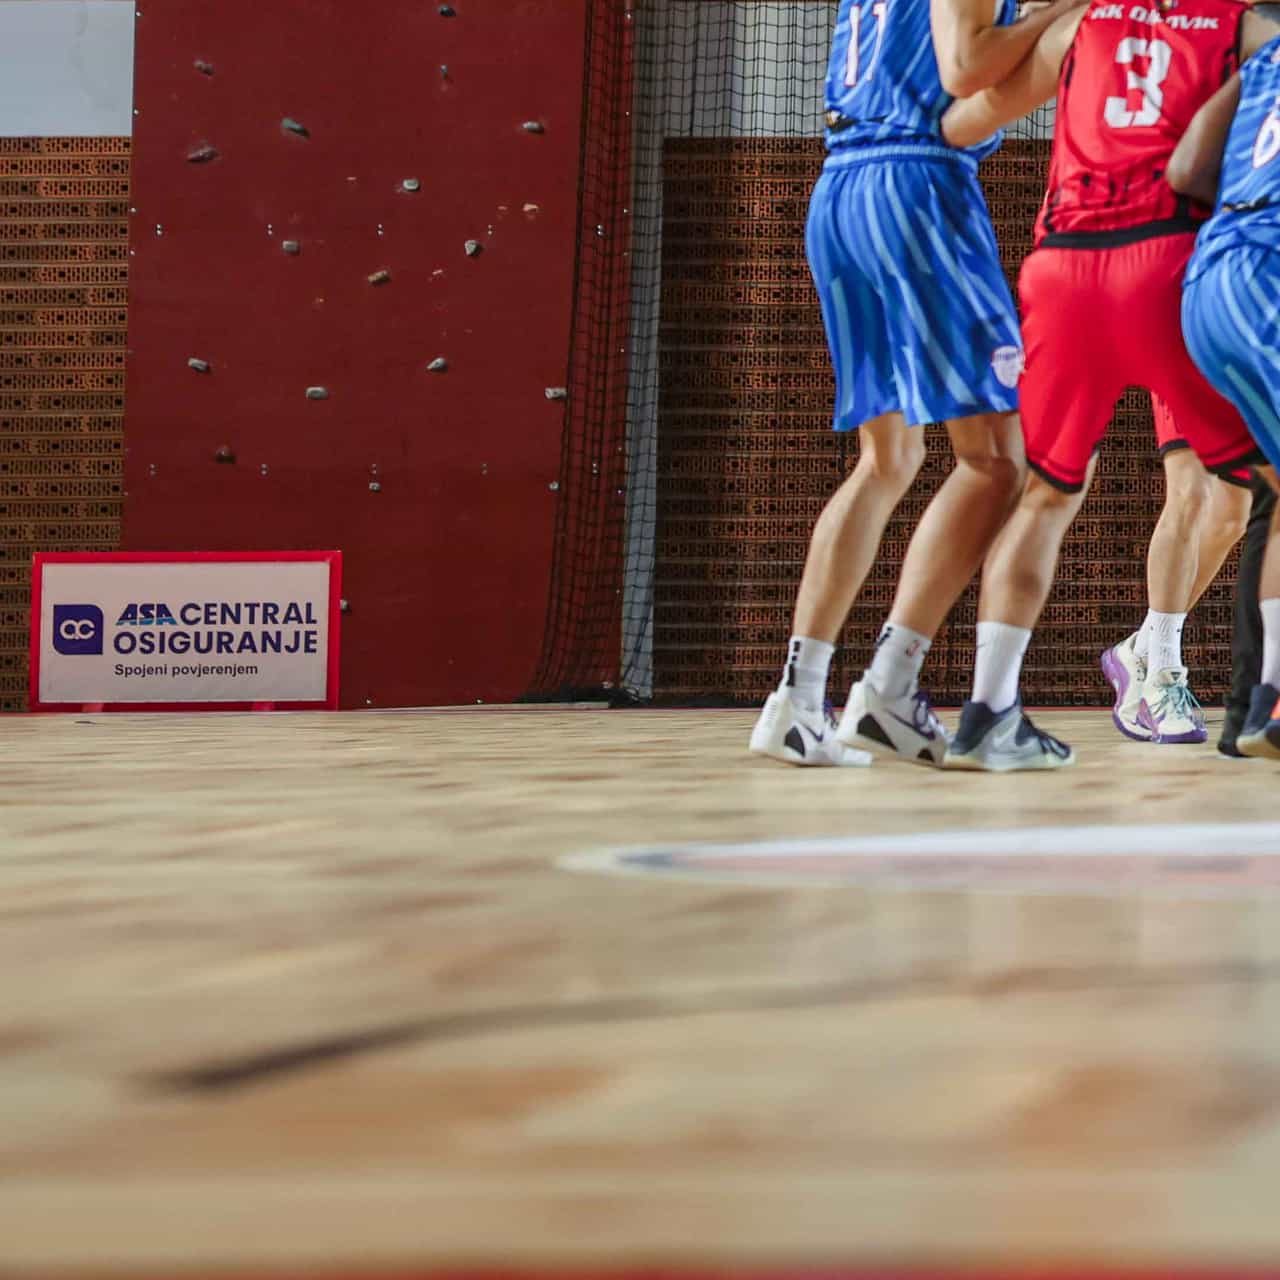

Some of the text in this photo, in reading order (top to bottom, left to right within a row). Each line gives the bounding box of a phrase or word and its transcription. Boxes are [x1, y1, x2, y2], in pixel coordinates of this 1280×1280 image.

[1104, 38, 1171, 129] 3
[115, 602, 318, 626] ASA CENTRAL
[114, 631, 318, 654] OSIGURANJE
[115, 663, 258, 678] Spojeni povjerenjem
